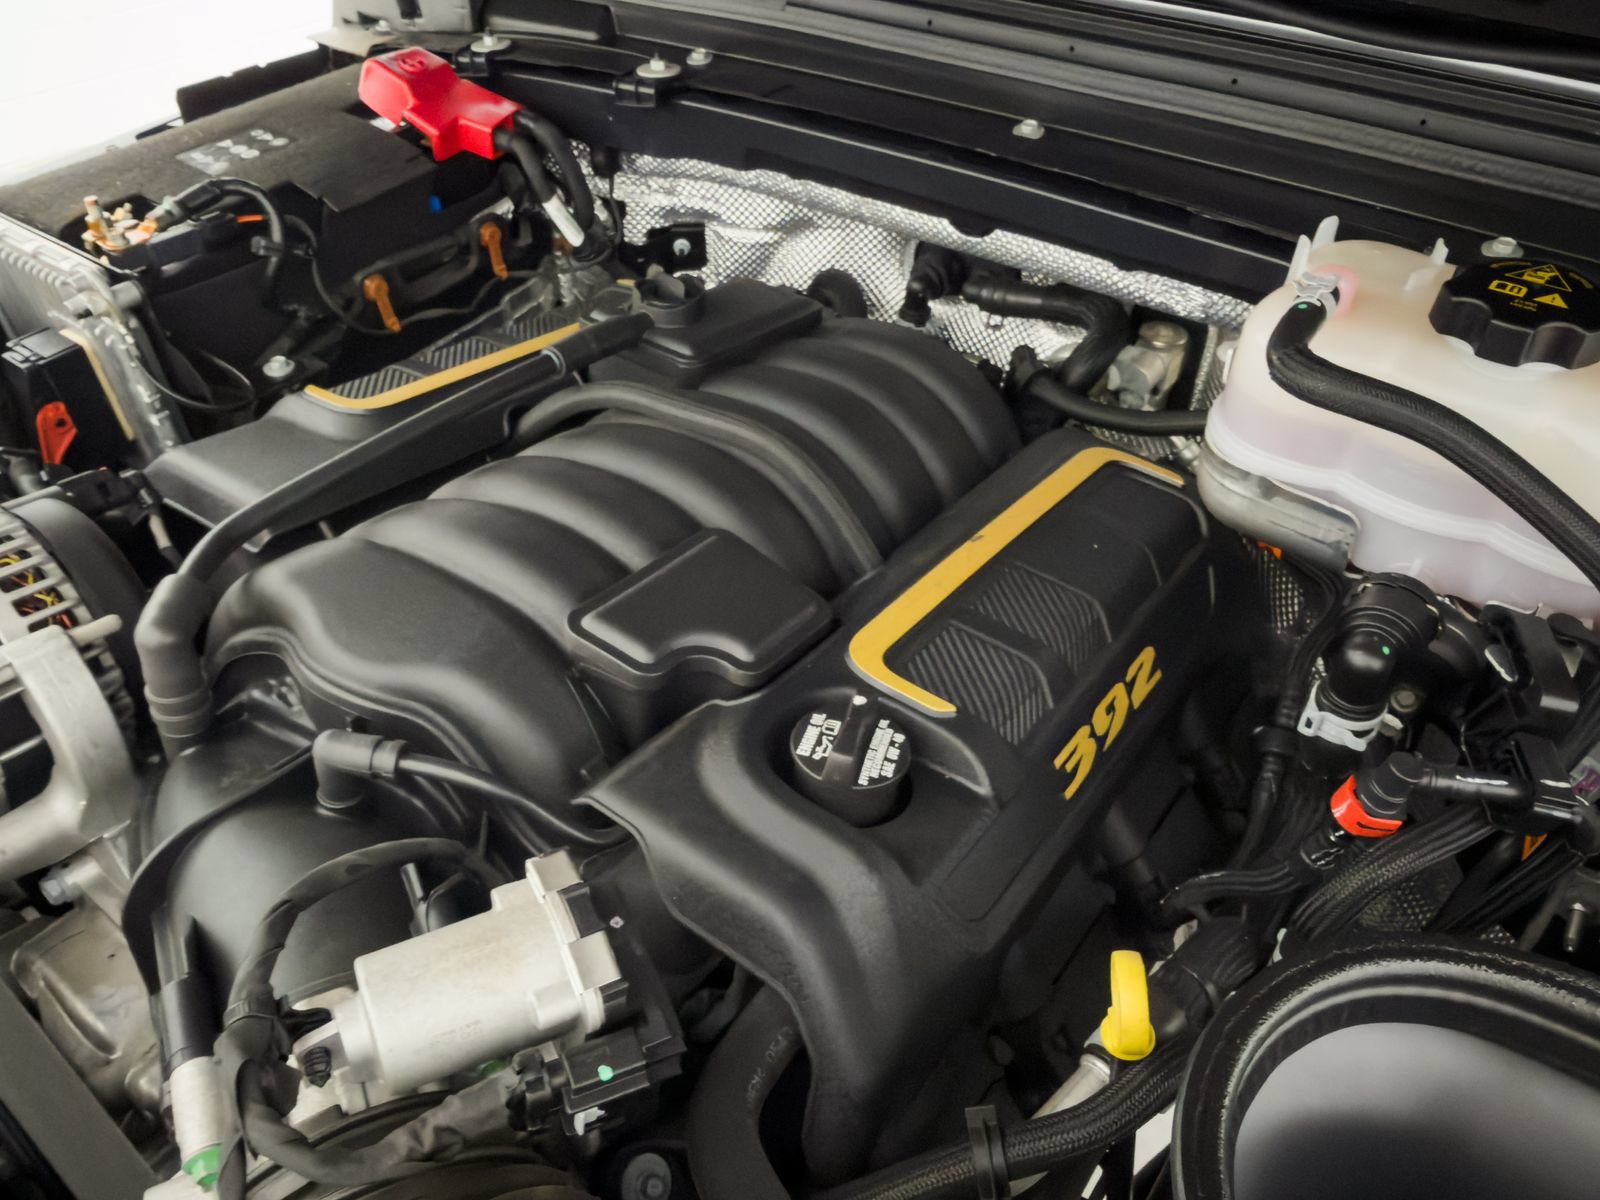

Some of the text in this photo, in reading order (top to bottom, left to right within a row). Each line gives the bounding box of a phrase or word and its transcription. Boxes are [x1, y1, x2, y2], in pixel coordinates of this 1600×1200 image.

[796, 713, 827, 756] ENGINE OIL
[1053, 646, 1162, 800] 392
[880, 761, 896, 778] SAE
